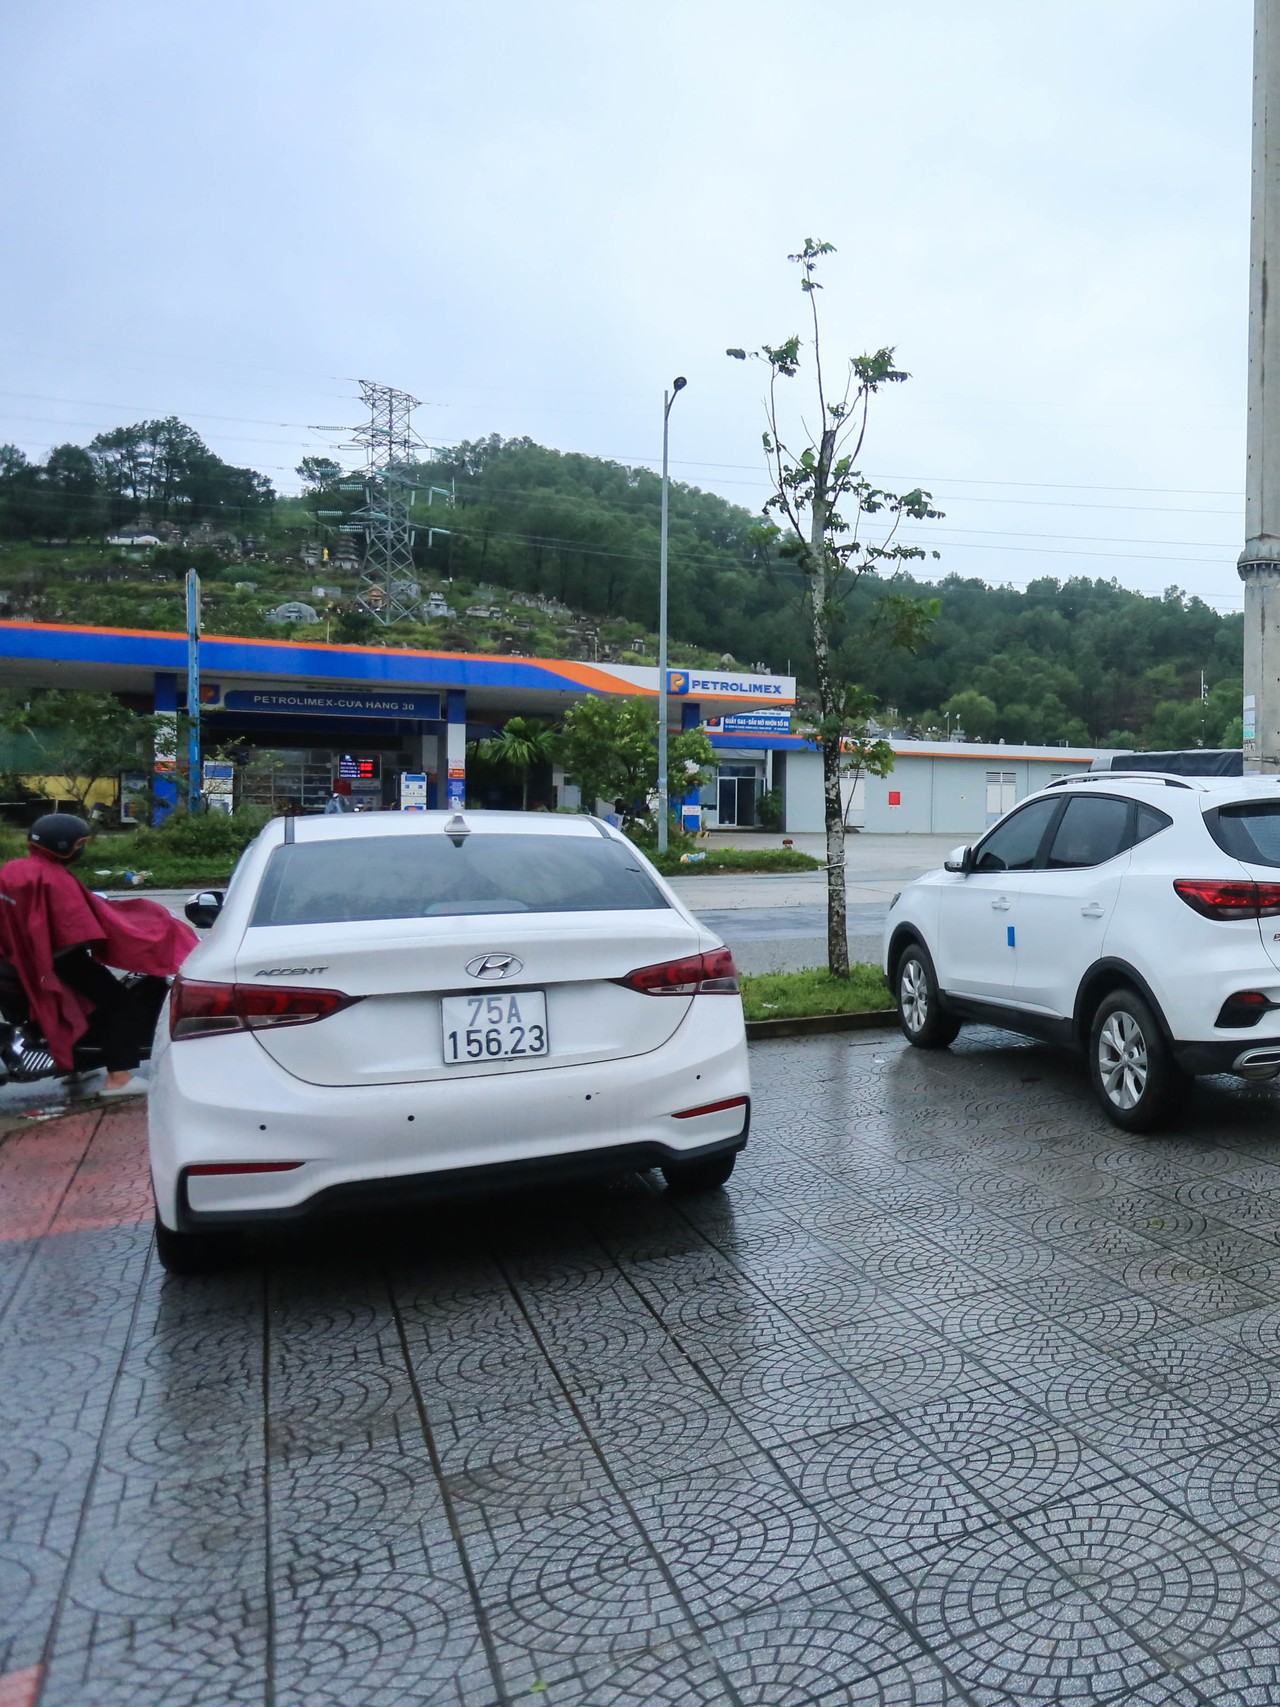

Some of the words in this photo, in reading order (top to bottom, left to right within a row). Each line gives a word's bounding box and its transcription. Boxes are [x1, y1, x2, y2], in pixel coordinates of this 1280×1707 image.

[692, 680, 782, 694] PETROLIMEX
[402, 703, 415, 711] 30
[255, 966, 329, 977] ACCENT
[467, 996, 522, 1027] 75A
[448, 1024, 545, 1060] 156.23
